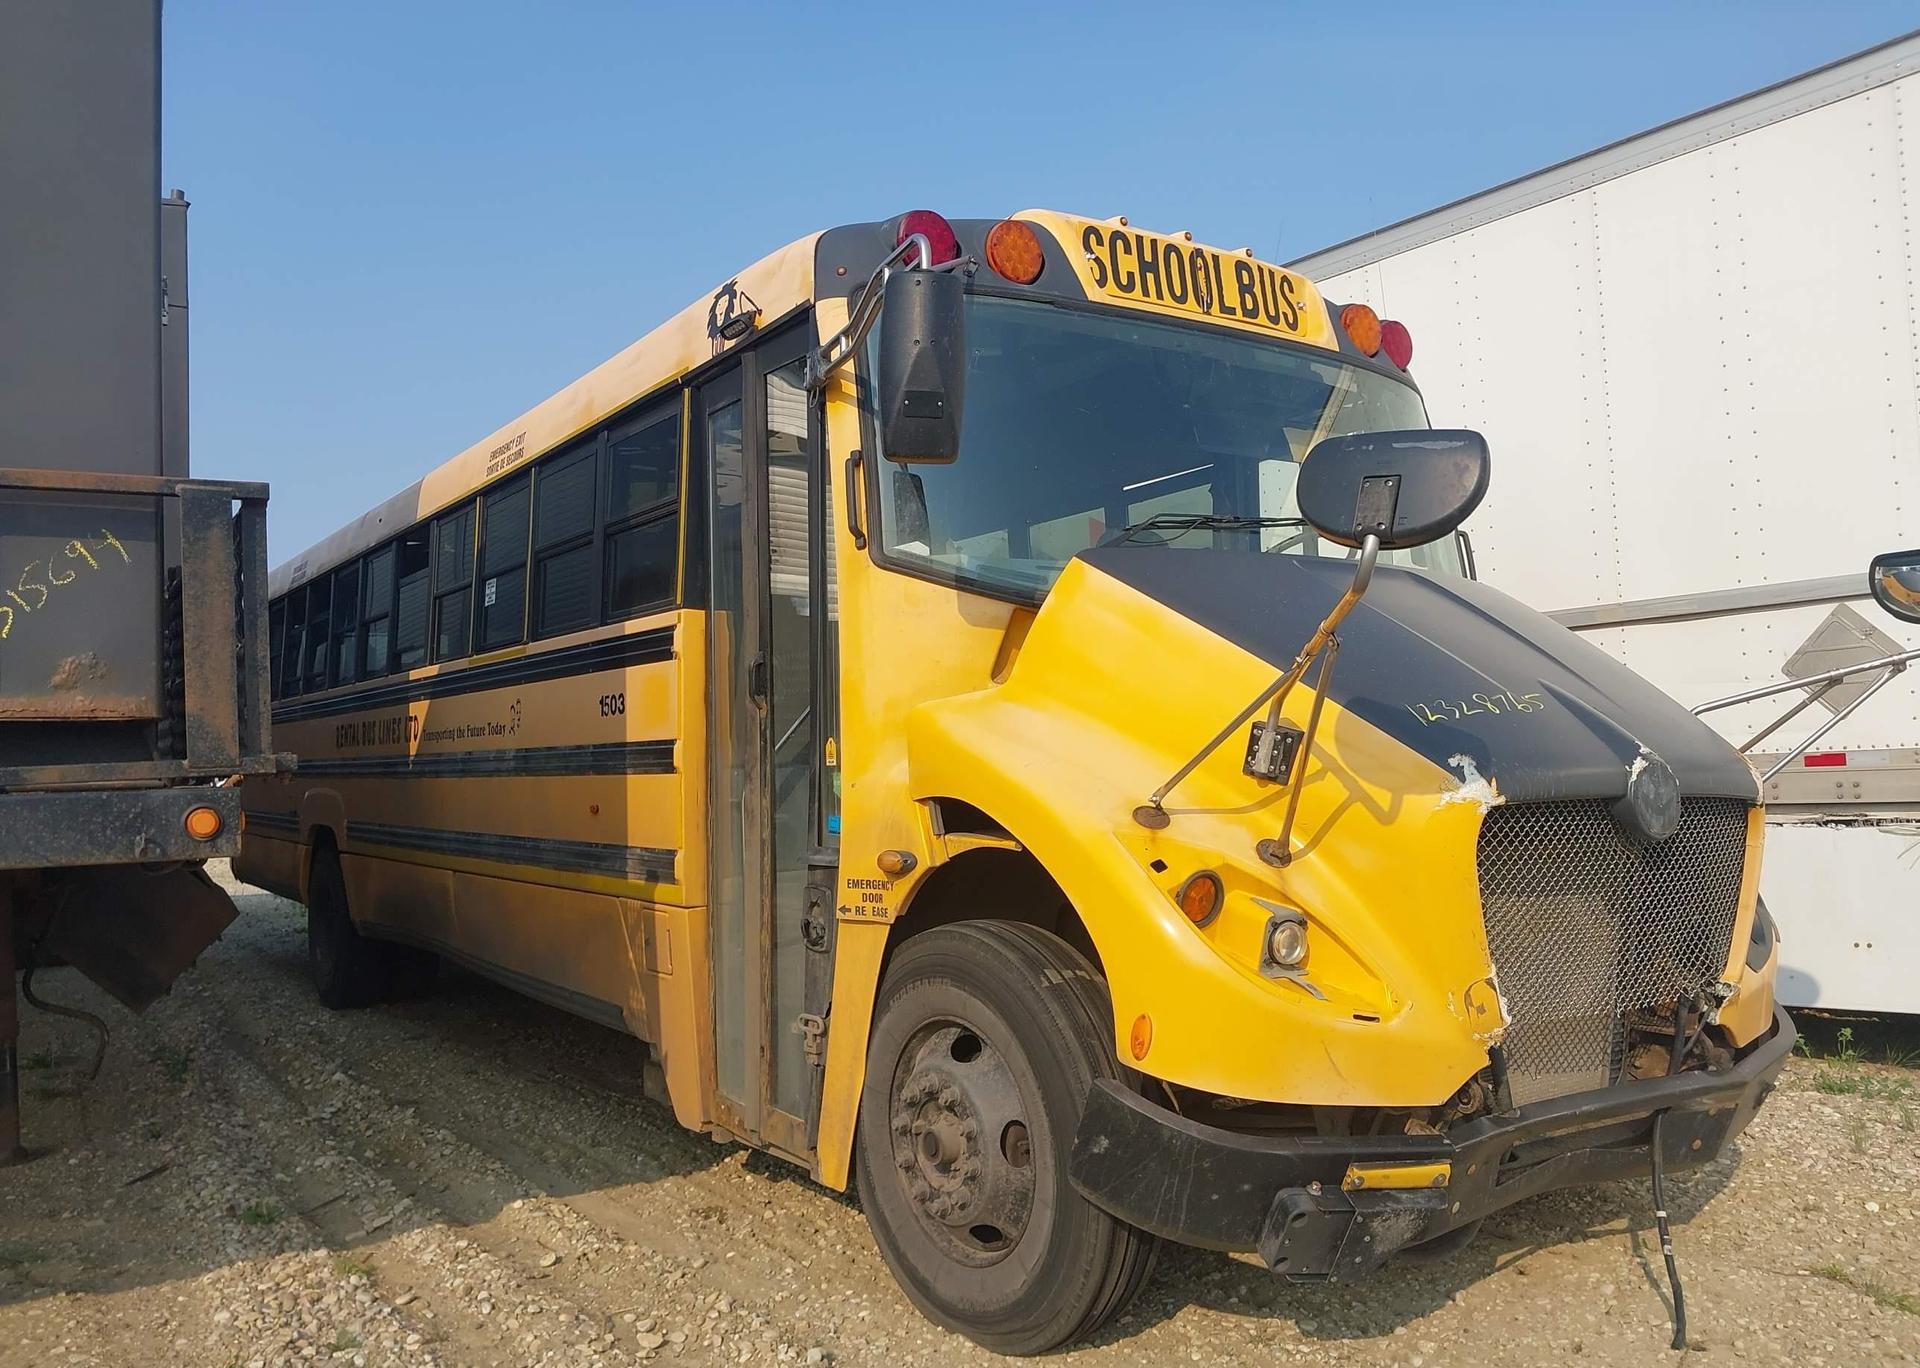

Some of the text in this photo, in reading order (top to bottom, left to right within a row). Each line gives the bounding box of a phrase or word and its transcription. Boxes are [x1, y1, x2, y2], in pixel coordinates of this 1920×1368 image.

[1082, 225, 1299, 331] SCHOOL BUS
[599, 692, 626, 717] 1503
[1404, 690, 1545, 728] 12328765
[456, 725, 466, 740] the
[466, 723, 487, 739] Future
[487, 721, 507, 738] Today
[846, 878, 896, 892] EMERGENCY
[861, 892, 884, 904] DOOR
